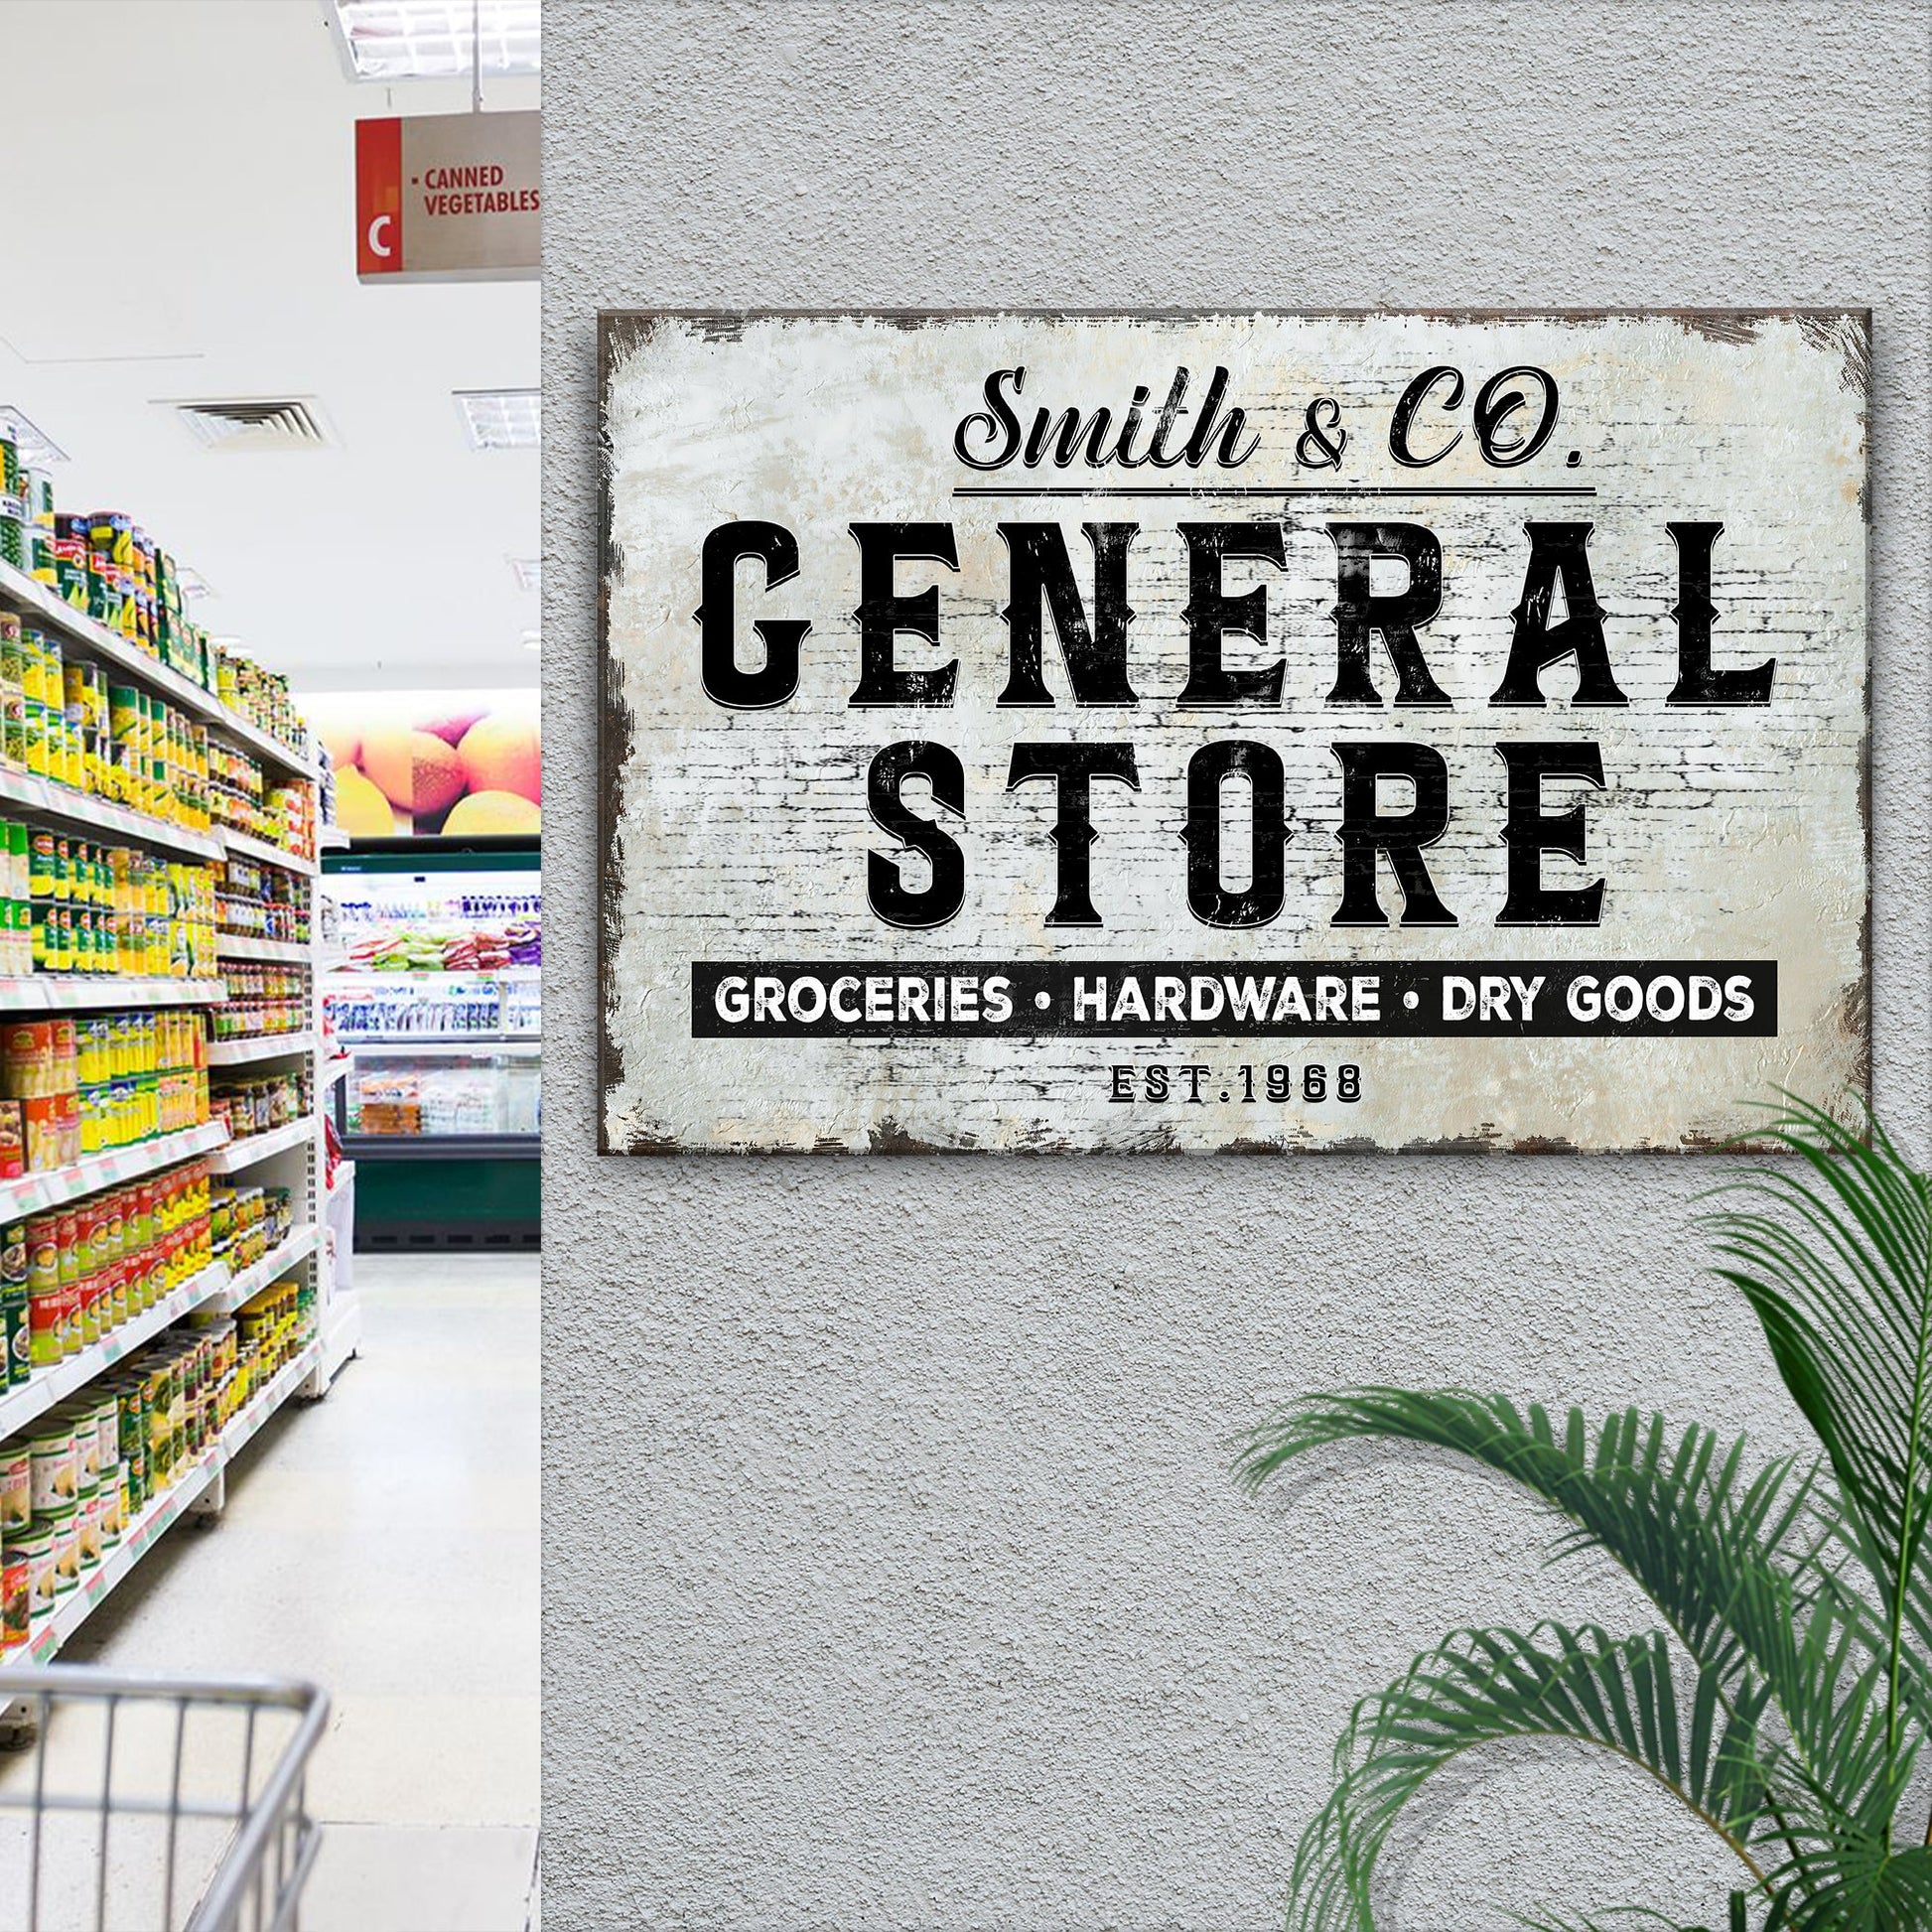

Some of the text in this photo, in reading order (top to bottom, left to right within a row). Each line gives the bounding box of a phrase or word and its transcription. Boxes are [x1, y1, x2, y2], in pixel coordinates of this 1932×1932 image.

[425, 165, 503, 190] CANNED
[424, 190, 540, 215] VEGETABLES
[367, 214, 391, 257] C
[953, 365, 1583, 471] Smith & CO.
[692, 519, 1777, 711] GENERAL
[866, 739, 1608, 931] STORE
[714, 975, 1755, 1024] GROCERIES HARDWARE DRY GOODS
